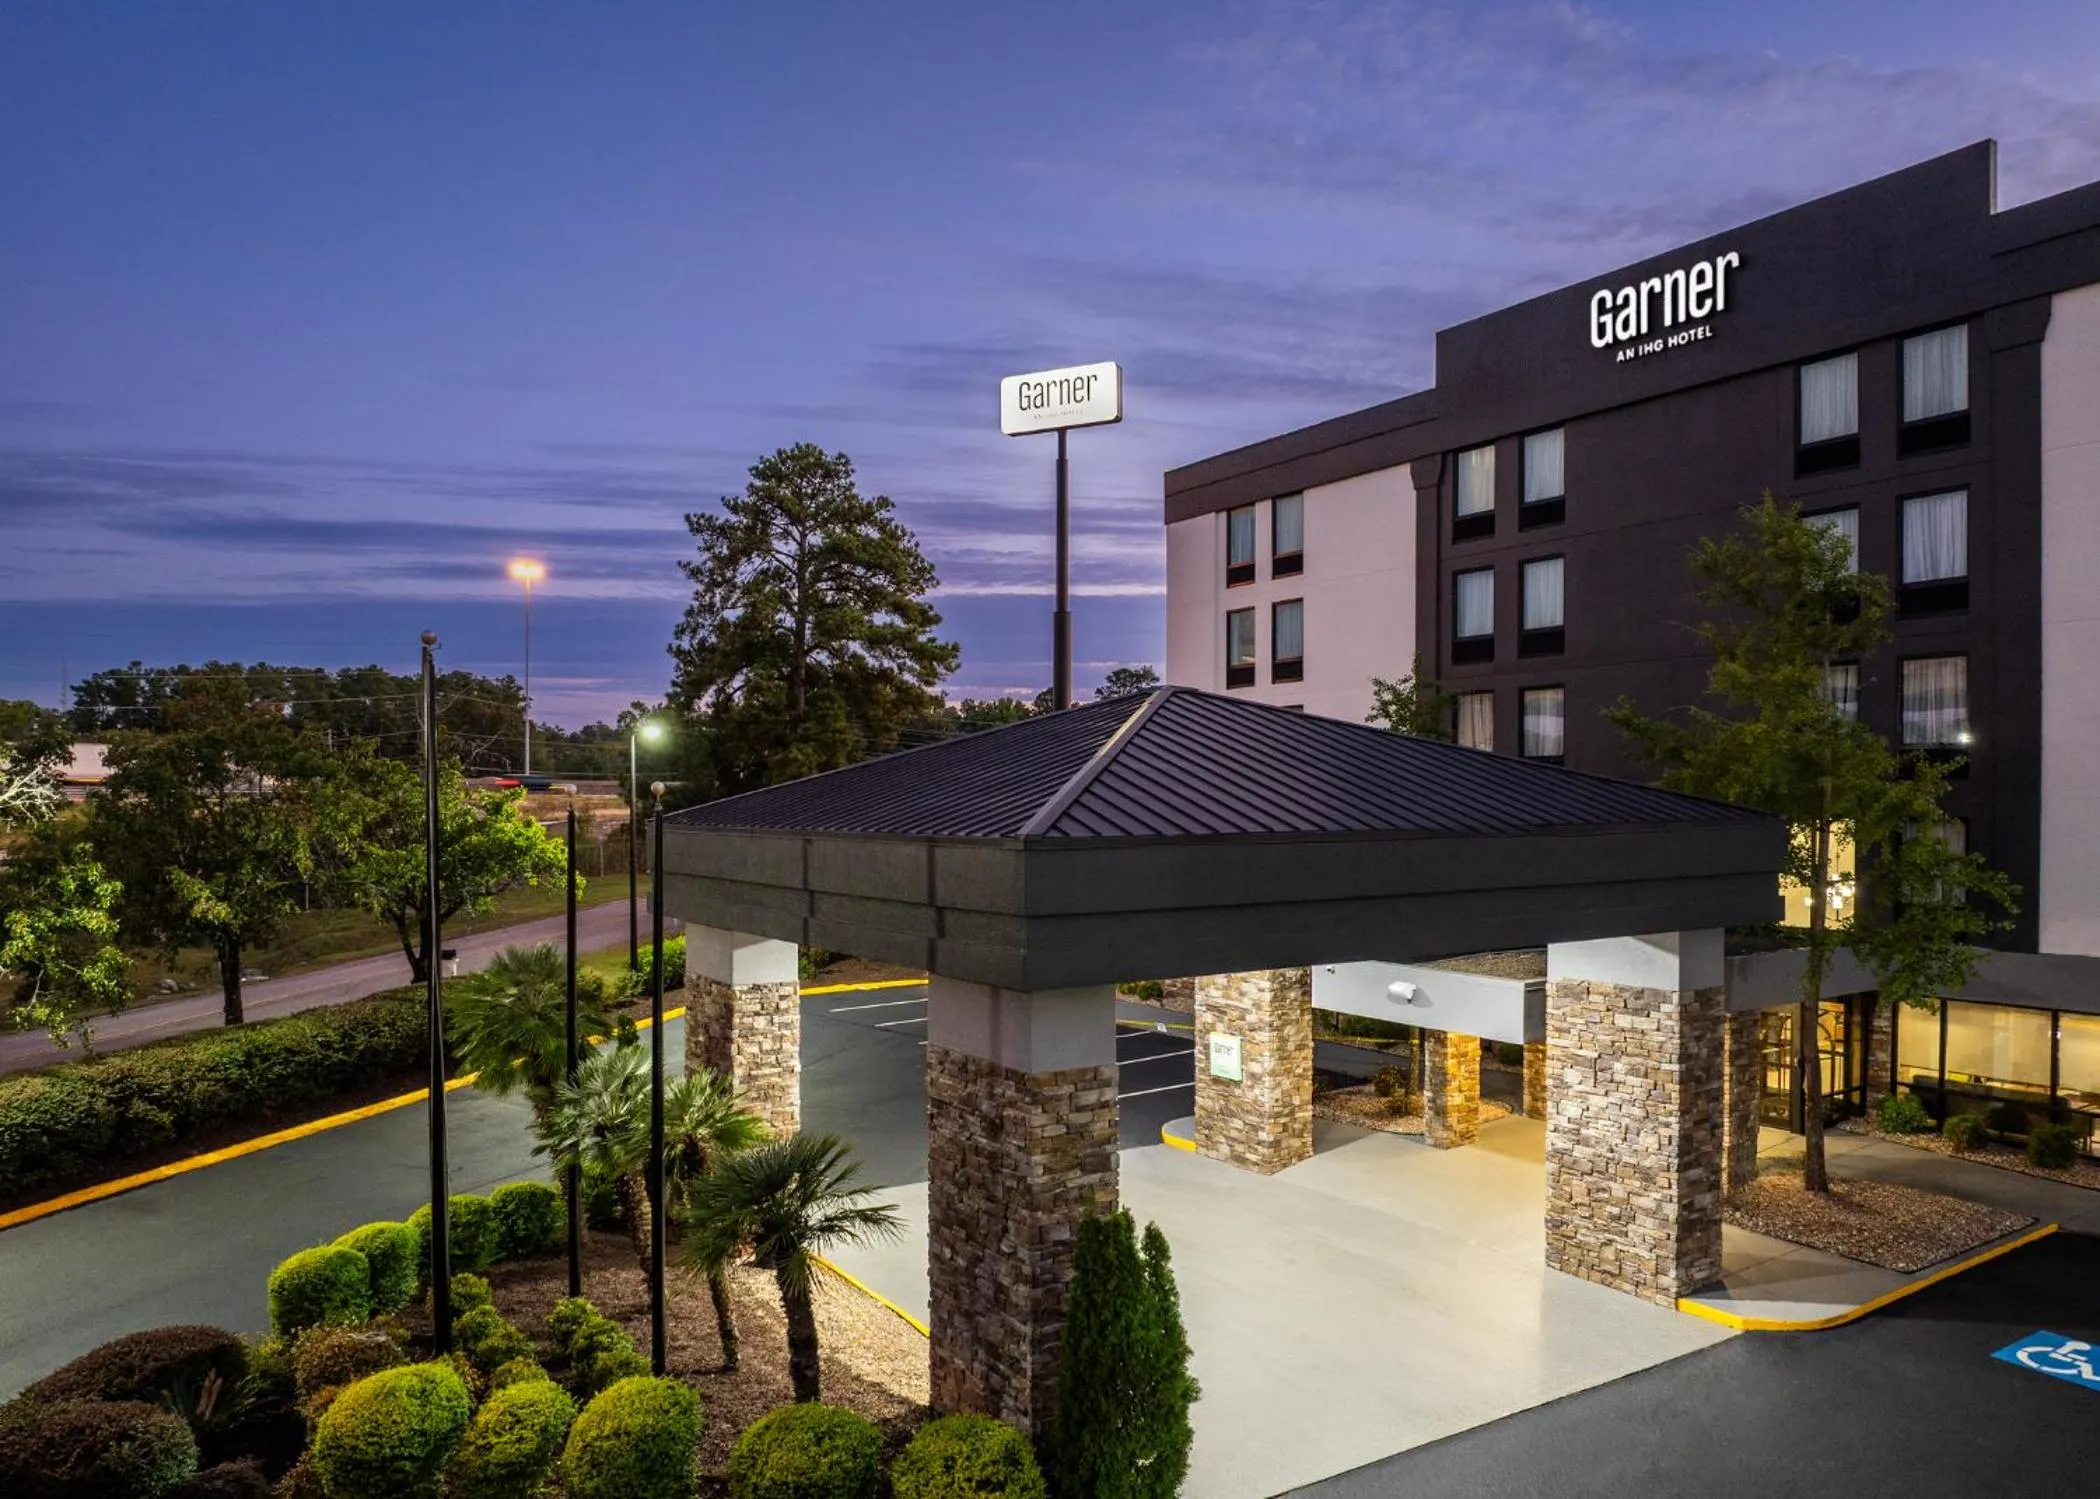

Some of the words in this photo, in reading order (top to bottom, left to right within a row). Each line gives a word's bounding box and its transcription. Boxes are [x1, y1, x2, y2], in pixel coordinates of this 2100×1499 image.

[1590, 251, 1740, 348] Garner
[1616, 348, 1635, 363] AN
[1638, 339, 1664, 356] IHG
[1668, 325, 1713, 347] HOTEL
[1019, 374, 1098, 411] Garner
